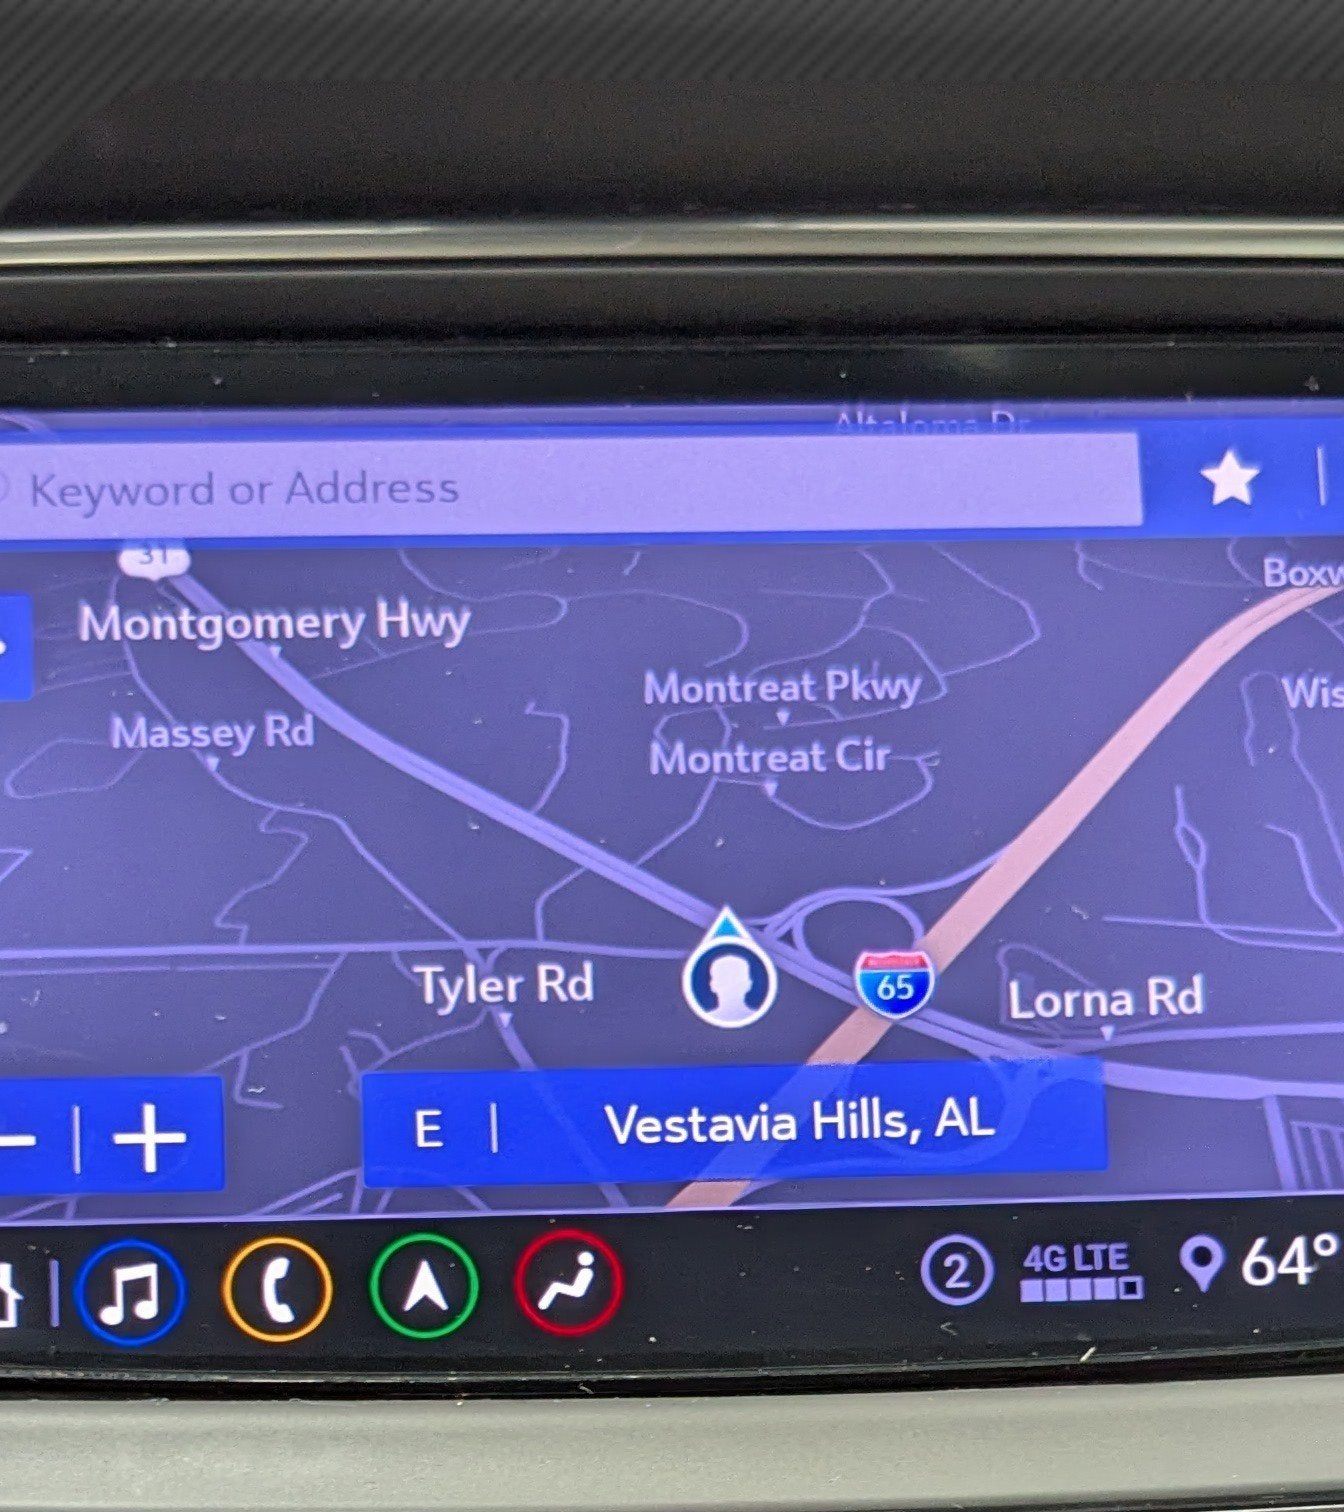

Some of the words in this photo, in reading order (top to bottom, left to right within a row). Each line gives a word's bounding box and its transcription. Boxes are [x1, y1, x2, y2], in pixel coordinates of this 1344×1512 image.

[30, 470, 215, 518] Keyword
[229, 475, 273, 505] or
[285, 469, 460, 505] Address
[78, 602, 365, 651] Montgomery
[377, 598, 472, 647] Hwy
[644, 672, 818, 703] Montreat
[826, 668, 922, 709] Pkwy
[111, 712, 255, 752] Massey
[264, 711, 315, 748] Rd
[650, 742, 828, 774] Montreat
[835, 736, 891, 773] Cir
[413, 964, 523, 1014] Tyler
[536, 961, 594, 1003] Rd
[877, 974, 915, 1000] 65
[1009, 978, 1134, 1020] Lorna
[1147, 973, 1204, 1016] Rd
[414, 1110, 443, 1147] E
[606, 1102, 798, 1145] Vestavia
[811, 1098, 921, 1144] Hills,
[934, 1097, 996, 1138] AL
[942, 1252, 972, 1292] 2
[1023, 1243, 1068, 1274] 4G
[1074, 1241, 1129, 1273] LTE
